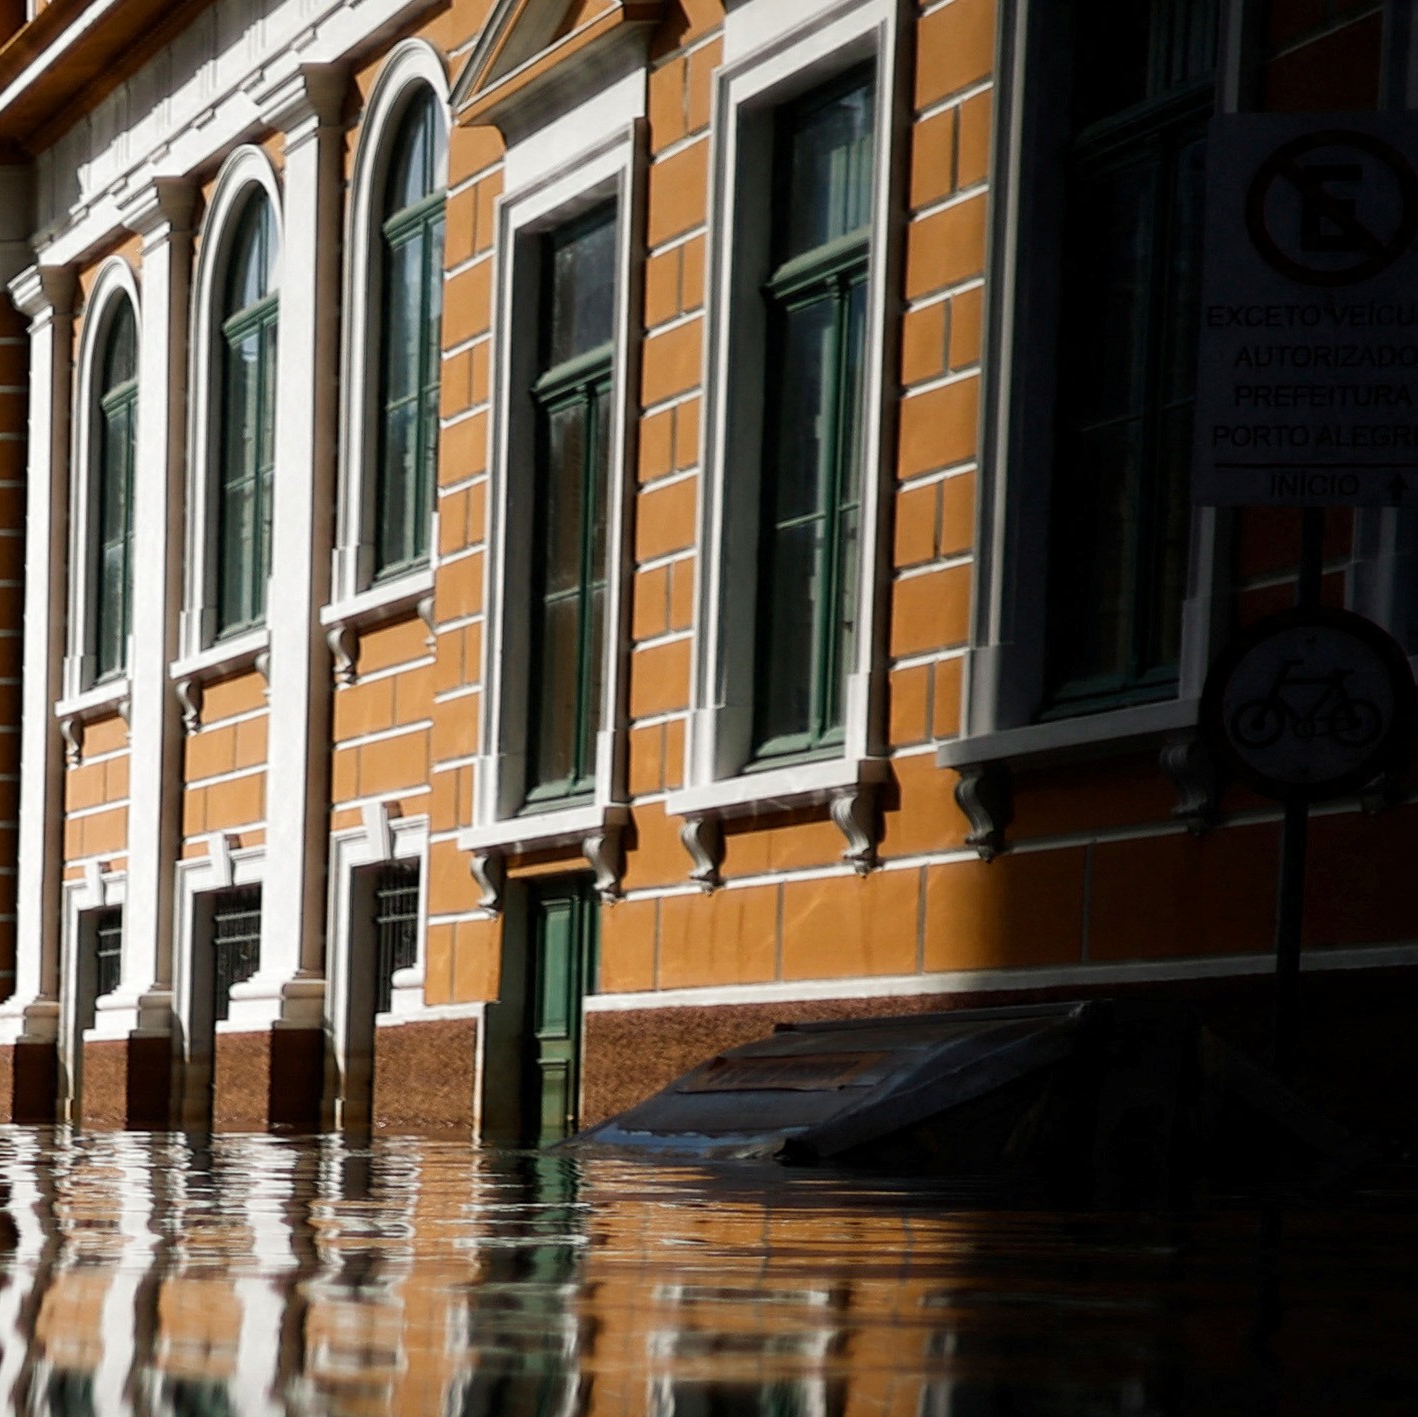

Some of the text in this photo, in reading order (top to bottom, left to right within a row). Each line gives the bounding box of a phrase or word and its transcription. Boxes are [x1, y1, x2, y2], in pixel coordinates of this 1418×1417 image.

[1206, 305, 1321, 327] EXCETO
[1233, 345, 1418, 367] AUTORIZADO
[1234, 384, 1413, 407] PREFEITURA
[1212, 425, 1310, 447] PORTO
[1270, 470, 1361, 497] INÍCIO
